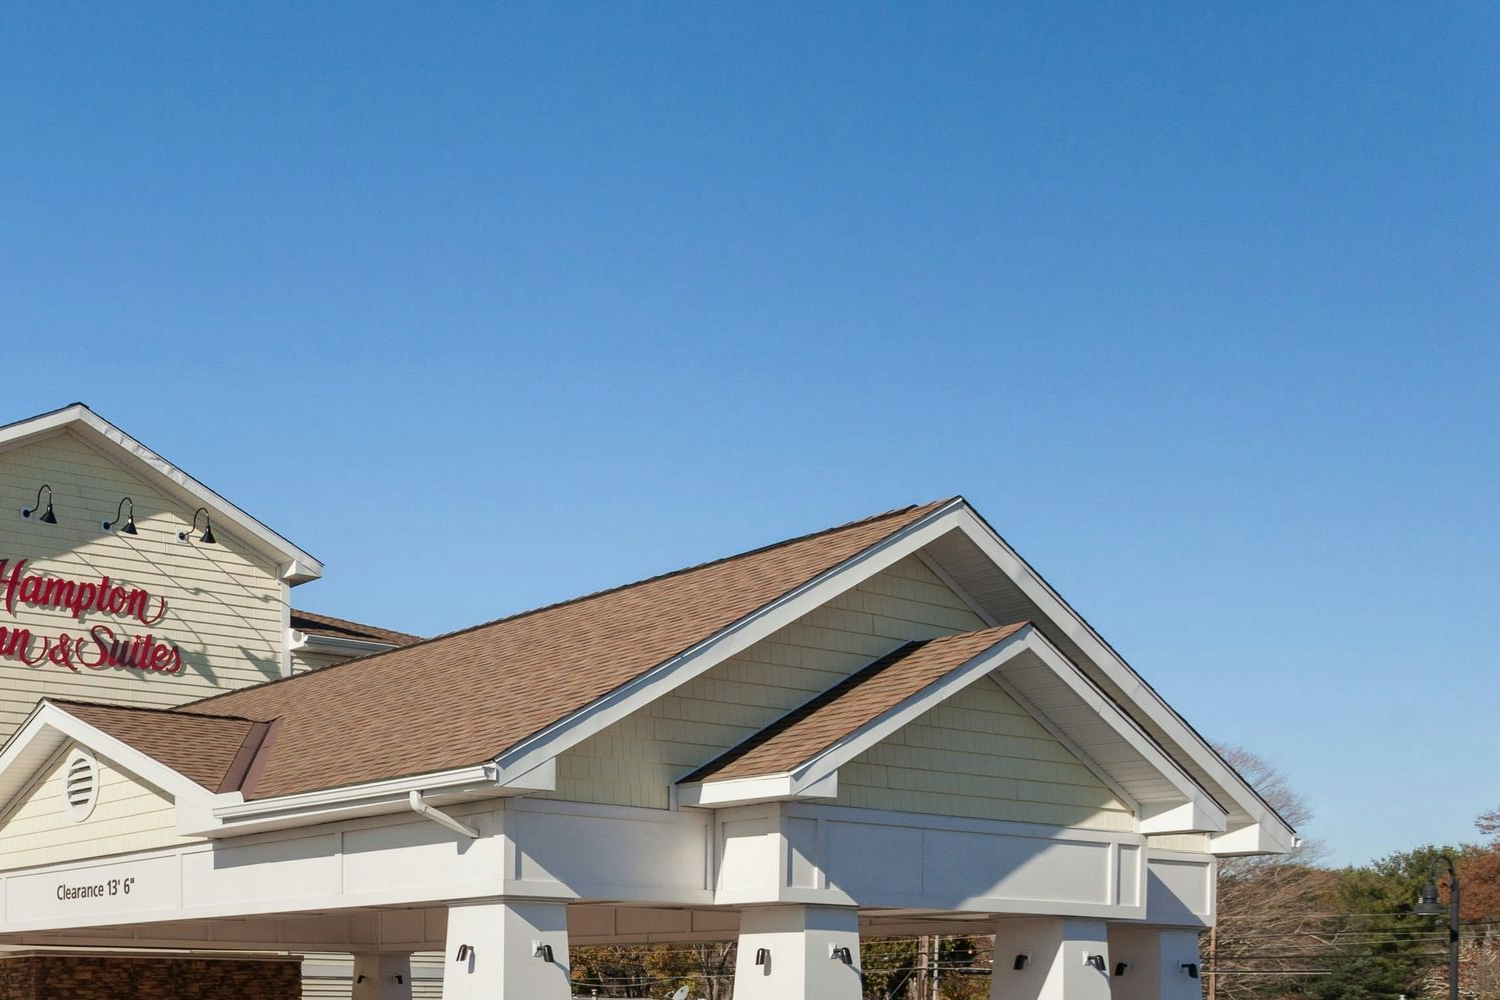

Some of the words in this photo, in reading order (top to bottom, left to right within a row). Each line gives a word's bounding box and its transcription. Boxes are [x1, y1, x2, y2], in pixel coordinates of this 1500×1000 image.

[49, 633, 78, 671] &
[76, 625, 182, 673] Suites
[57, 884, 104, 900] Clearance
[107, 879, 120, 896] 13'
[123, 877, 135, 895] 6"
